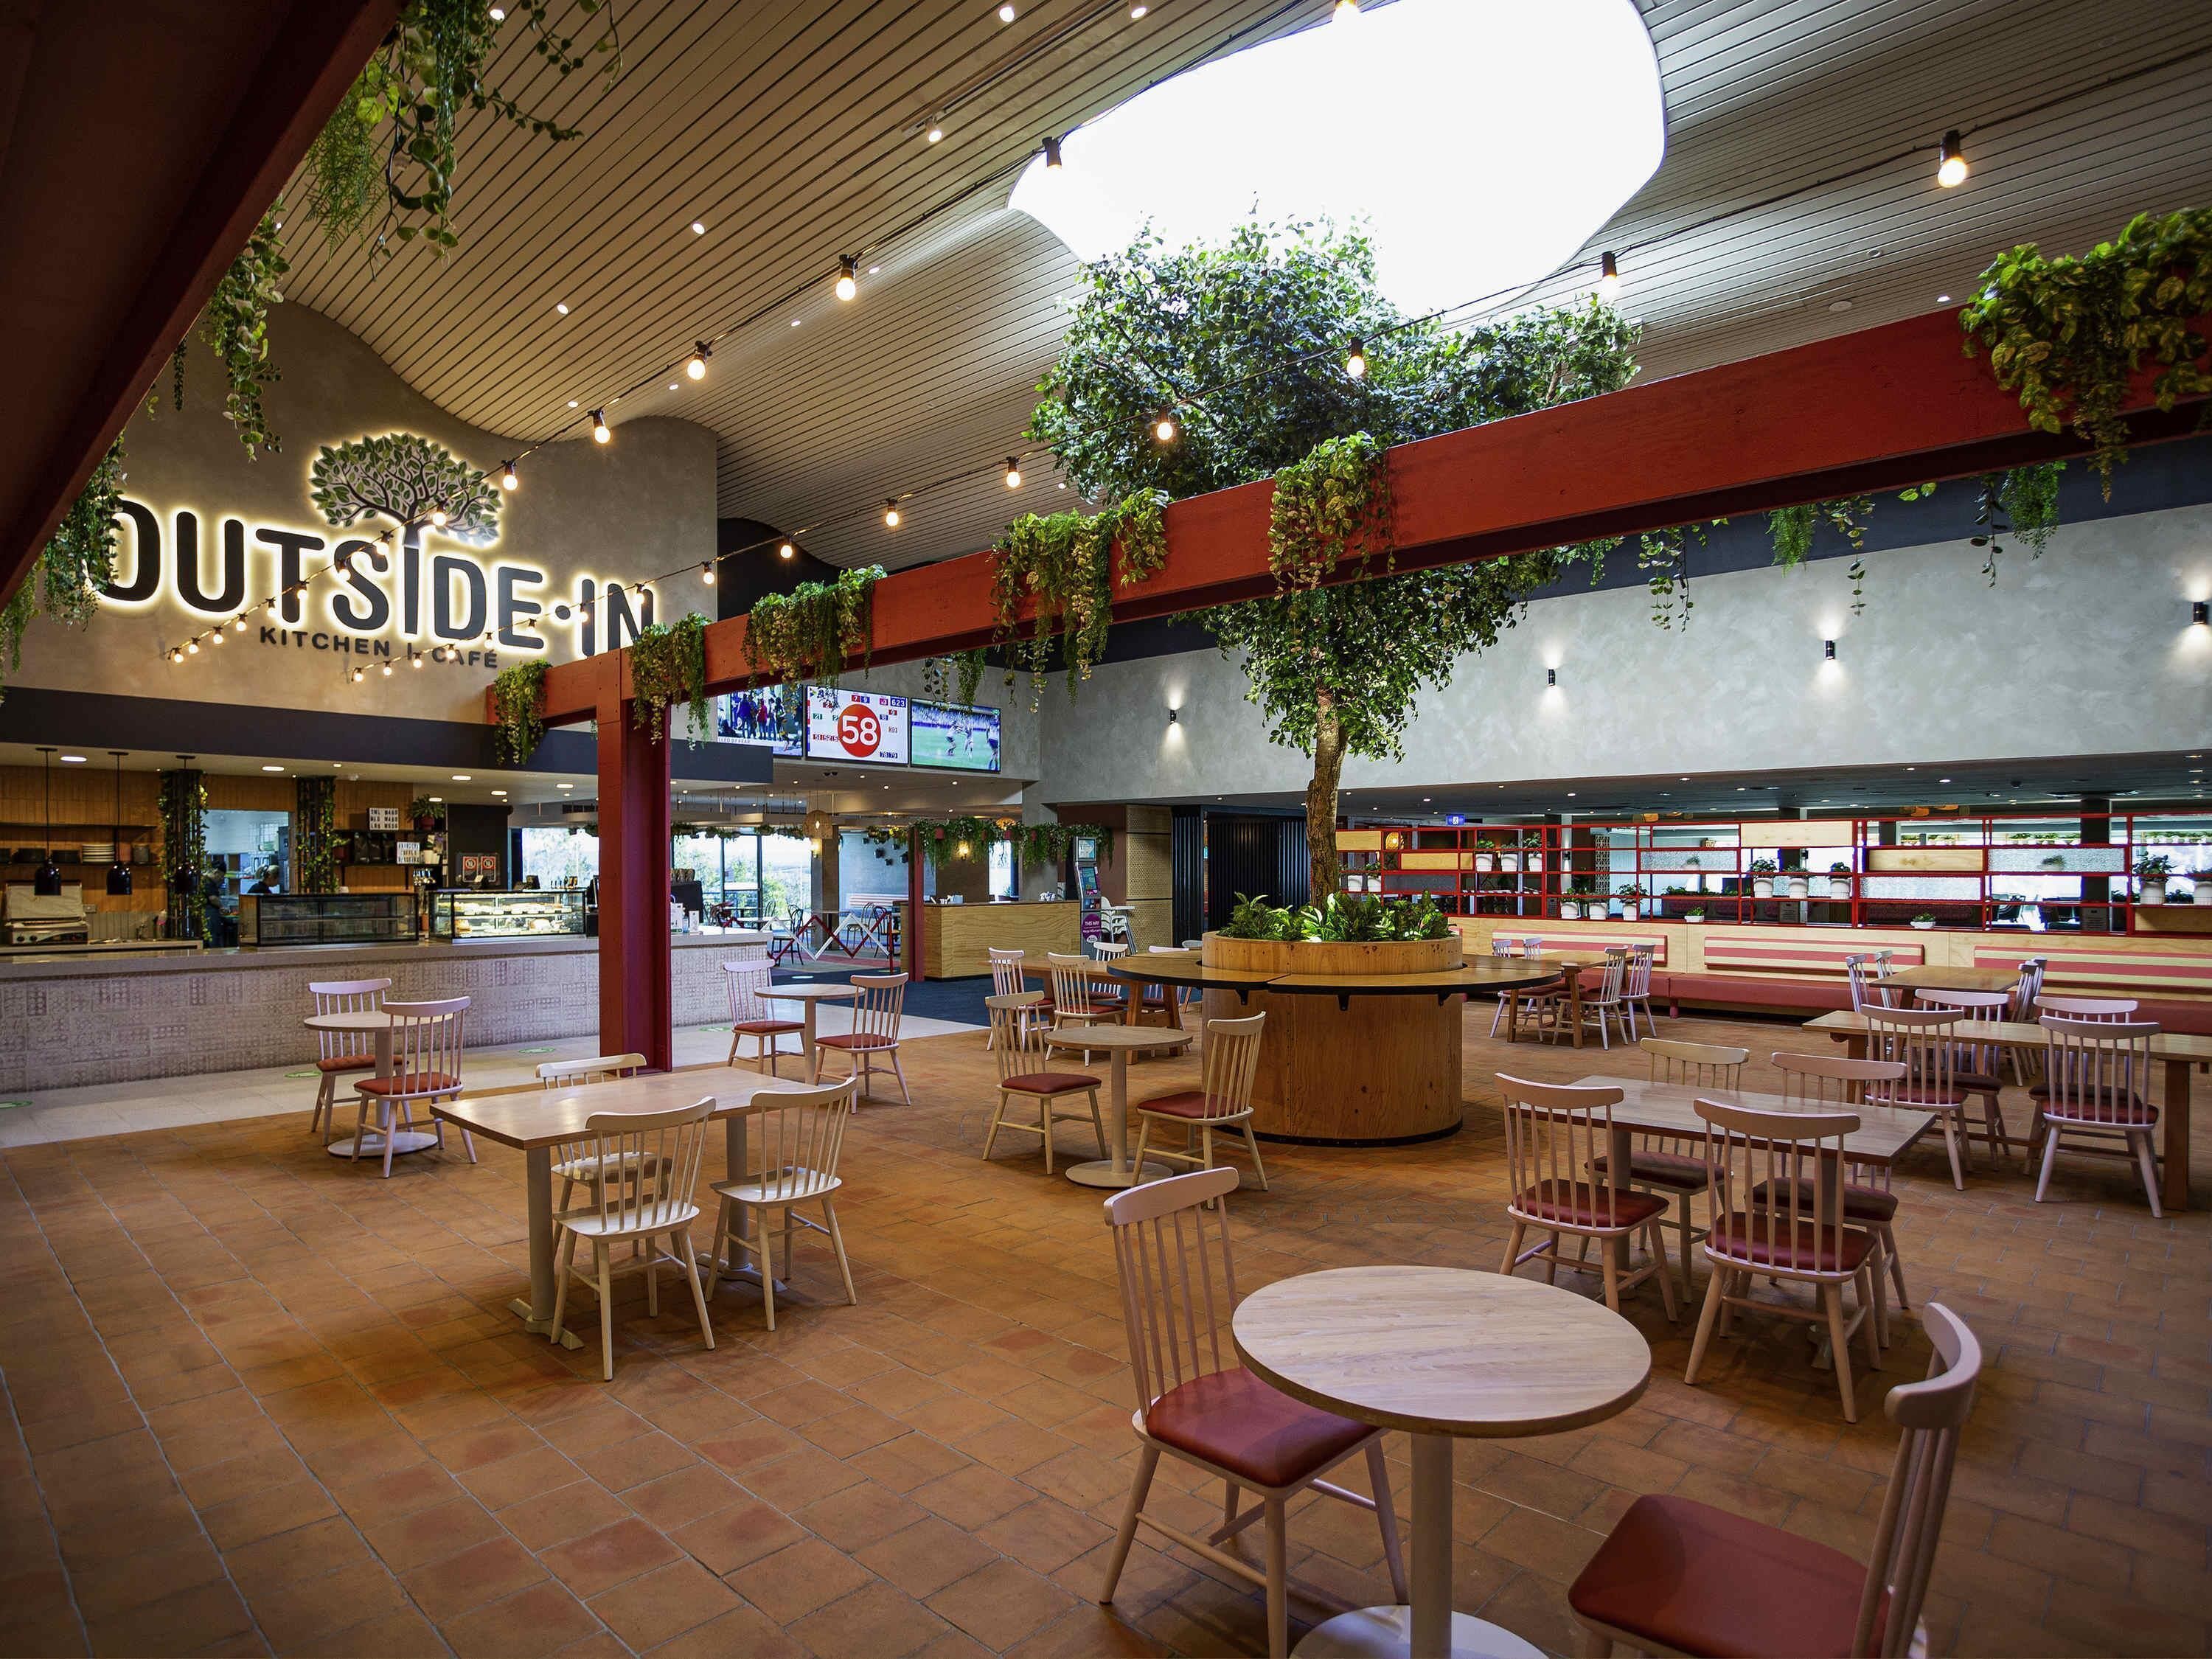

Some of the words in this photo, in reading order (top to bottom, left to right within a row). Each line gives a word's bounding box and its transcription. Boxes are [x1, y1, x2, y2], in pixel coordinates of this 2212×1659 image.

[260, 626, 391, 656] KITCHEN
[432, 647, 498, 668] CAFÉ
[891, 698, 905, 707] 623
[842, 714, 878, 746] 58
